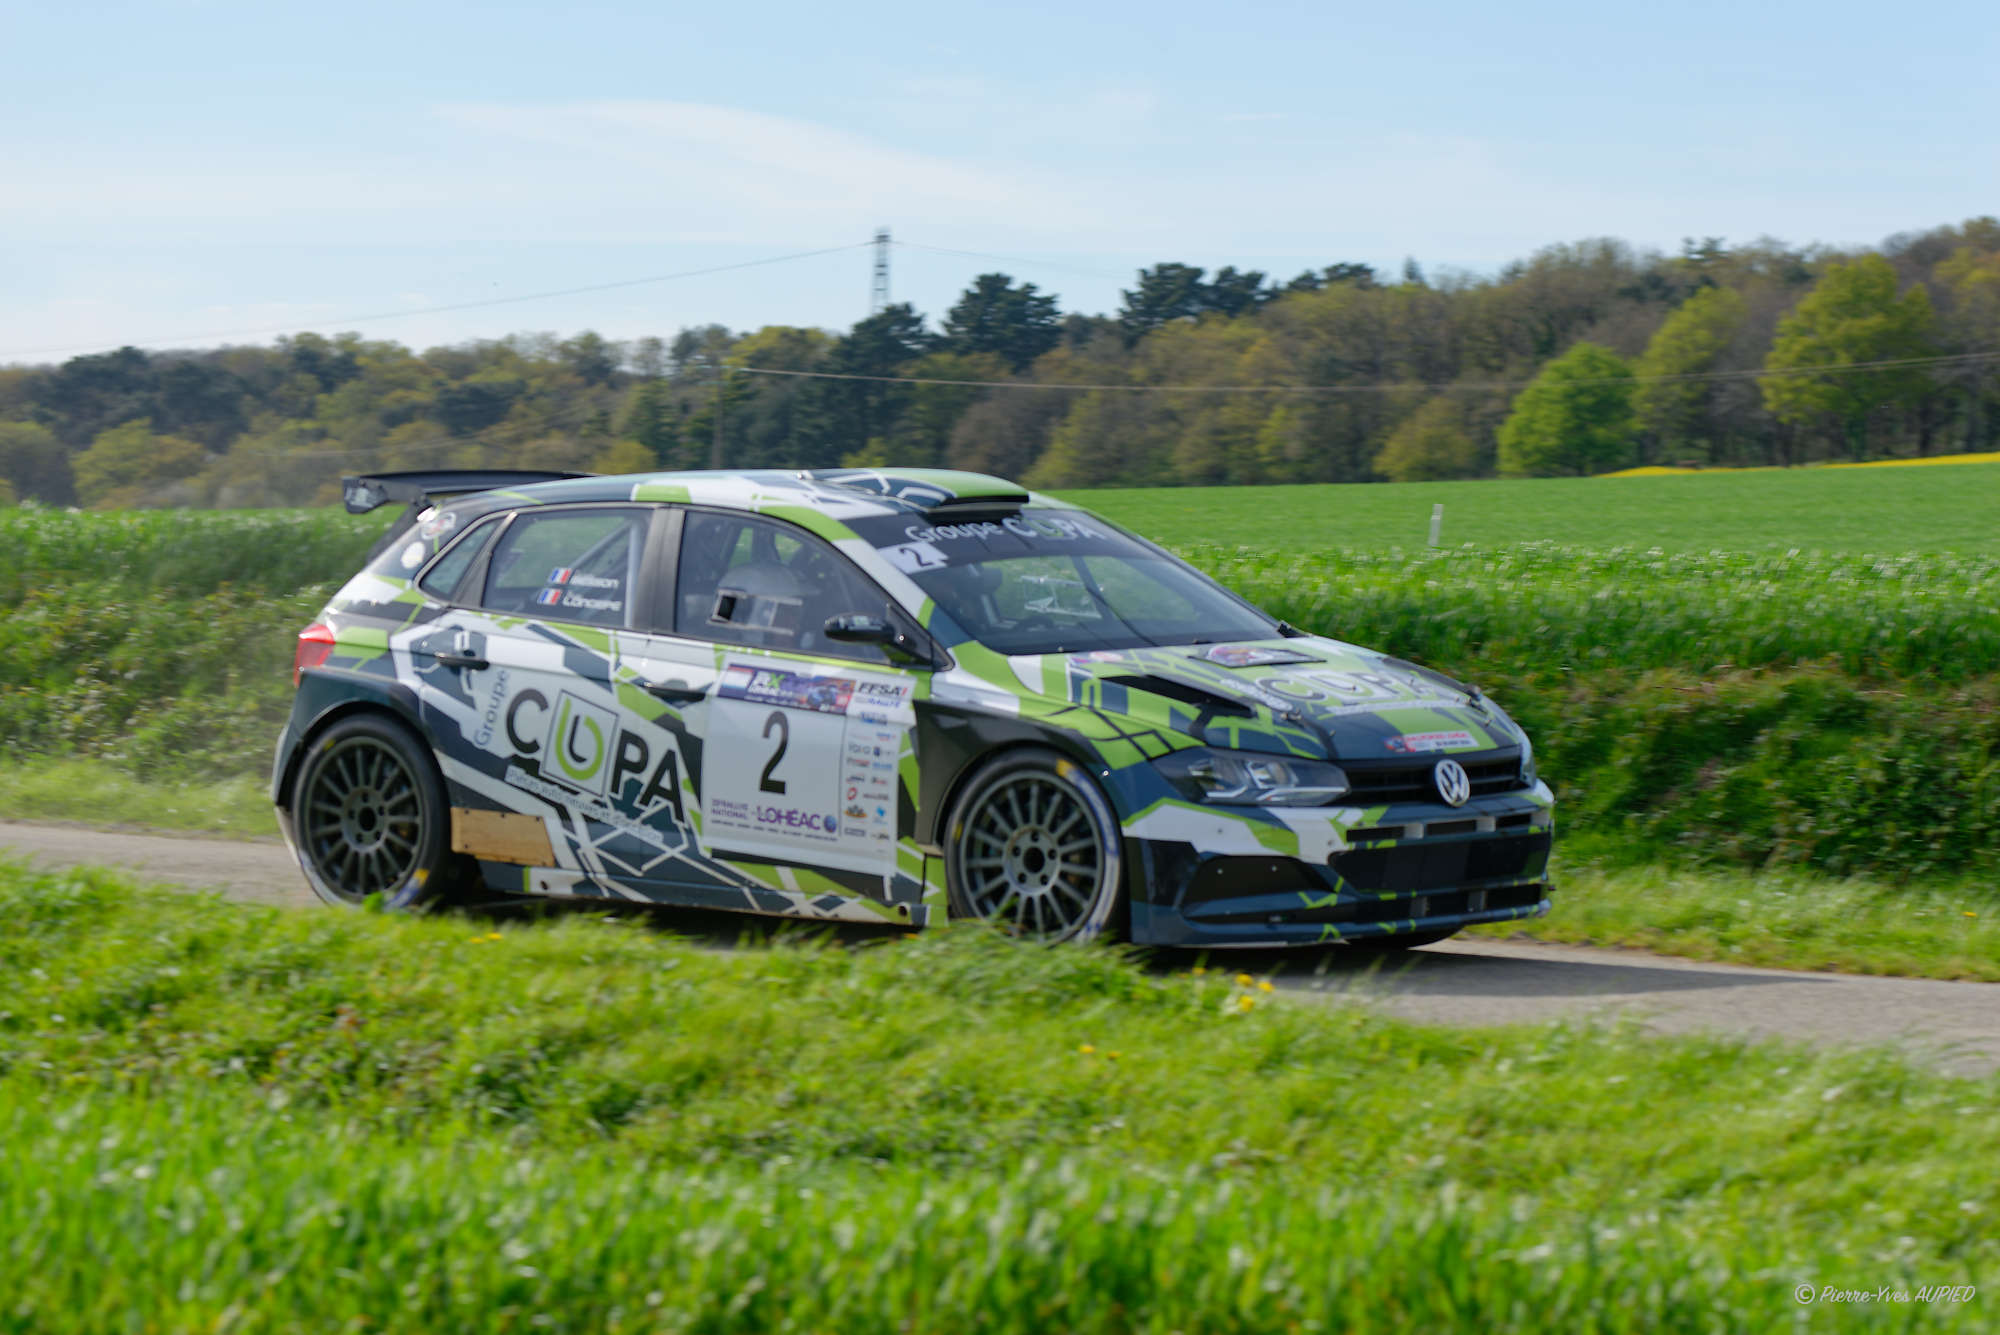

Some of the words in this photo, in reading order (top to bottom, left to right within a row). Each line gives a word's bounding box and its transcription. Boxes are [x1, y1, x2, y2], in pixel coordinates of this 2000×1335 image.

[905, 518, 1003, 543] Groupe
[900, 547, 934, 568] 2
[858, 682, 902, 697] FFSA
[474, 669, 510, 746] Groupe
[760, 710, 789, 795] 2
[757, 806, 821, 830] LOHÉAC
